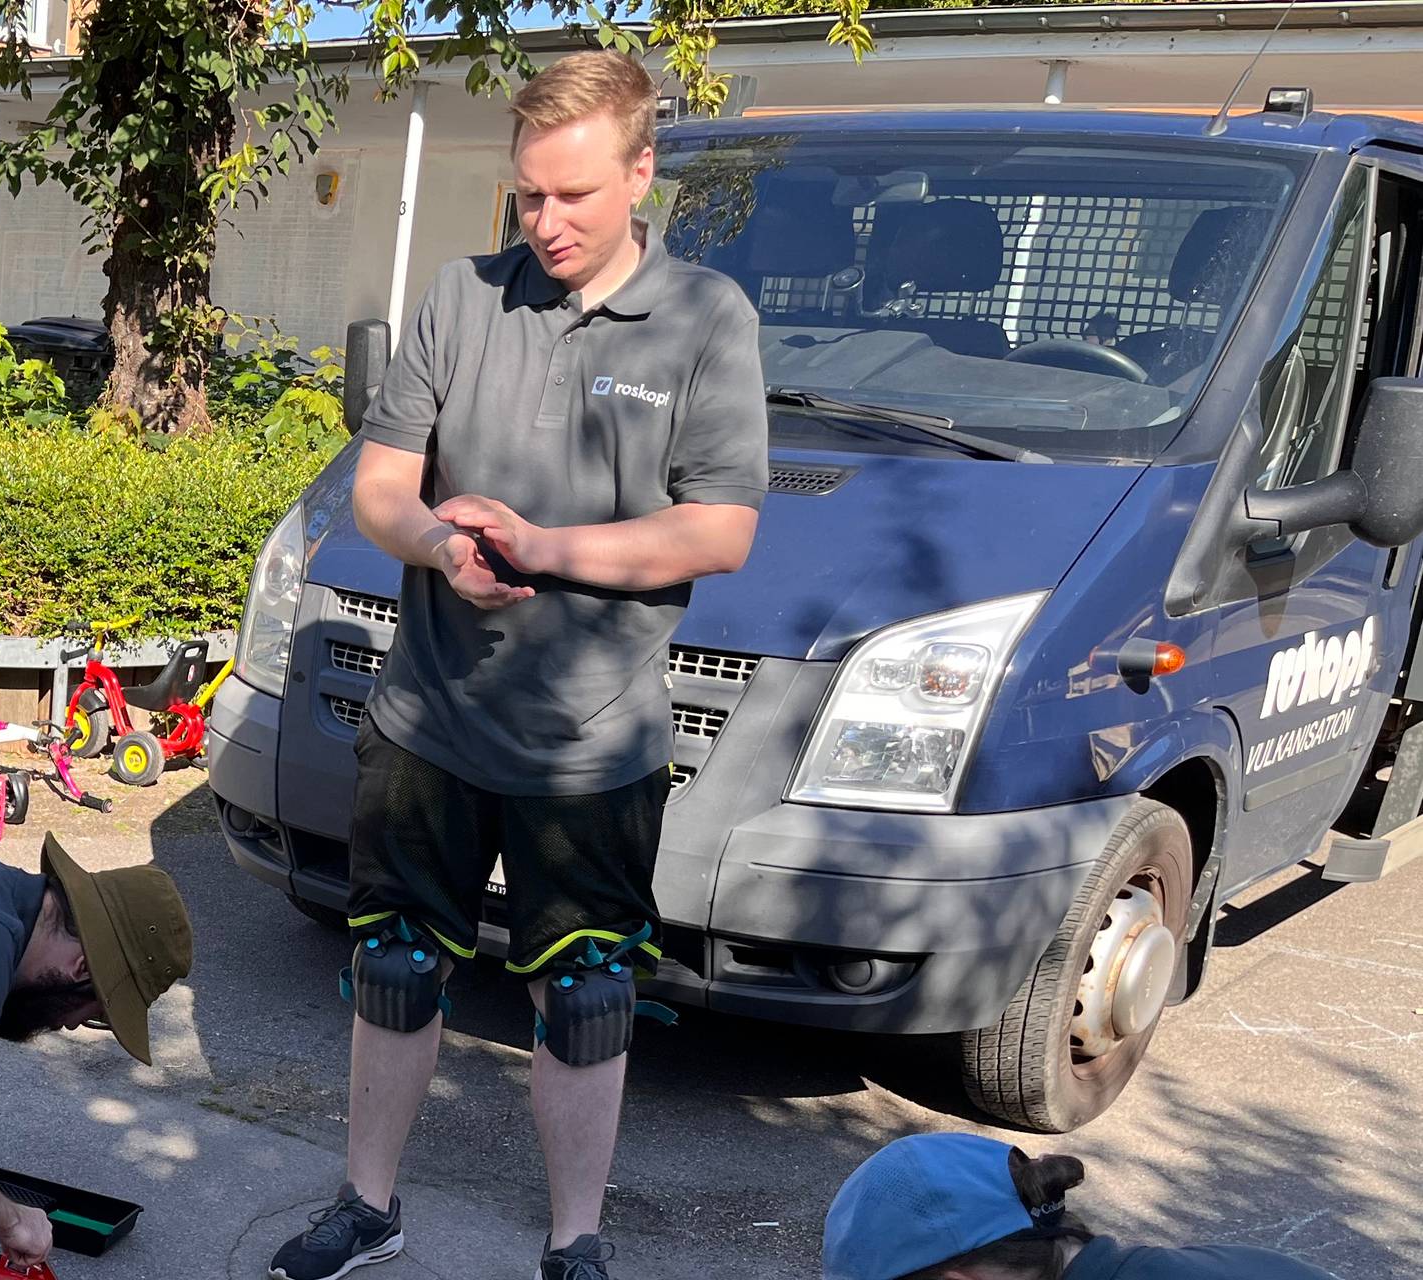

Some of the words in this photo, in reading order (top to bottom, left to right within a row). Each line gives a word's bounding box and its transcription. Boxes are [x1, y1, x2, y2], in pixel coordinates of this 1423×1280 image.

[399, 200, 406, 215] 3
[614, 383, 671, 407] roskopf
[1245, 705, 1357, 776] VULKANISATION
